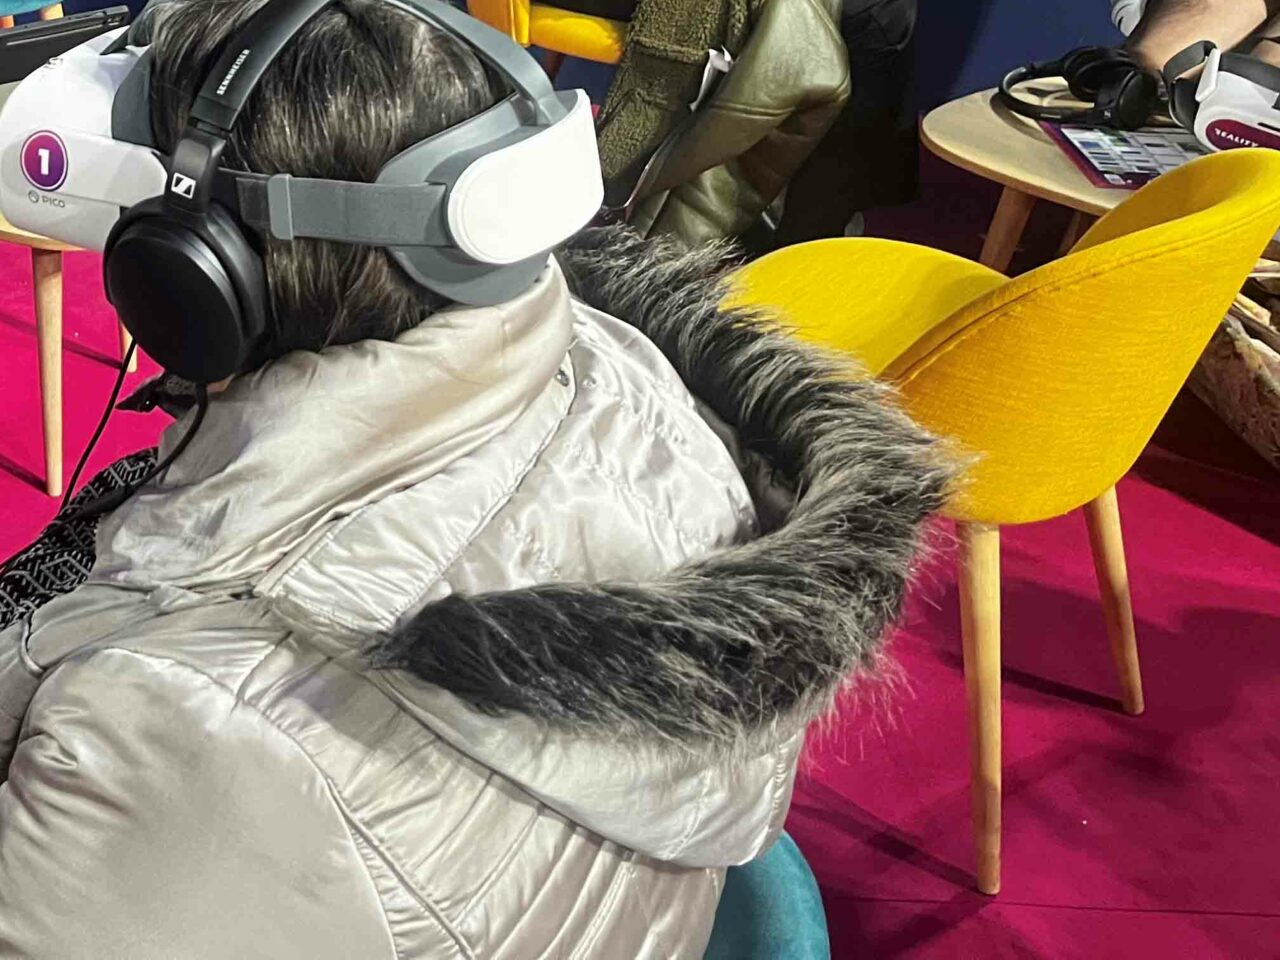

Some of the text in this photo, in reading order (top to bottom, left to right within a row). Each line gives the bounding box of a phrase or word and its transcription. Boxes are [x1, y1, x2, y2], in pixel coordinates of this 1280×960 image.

[216, 49, 250, 95] SENNHEISER
[1214, 127, 1259, 148] REALITY
[38, 148, 50, 176] 1
[42, 195, 66, 208] PICO
